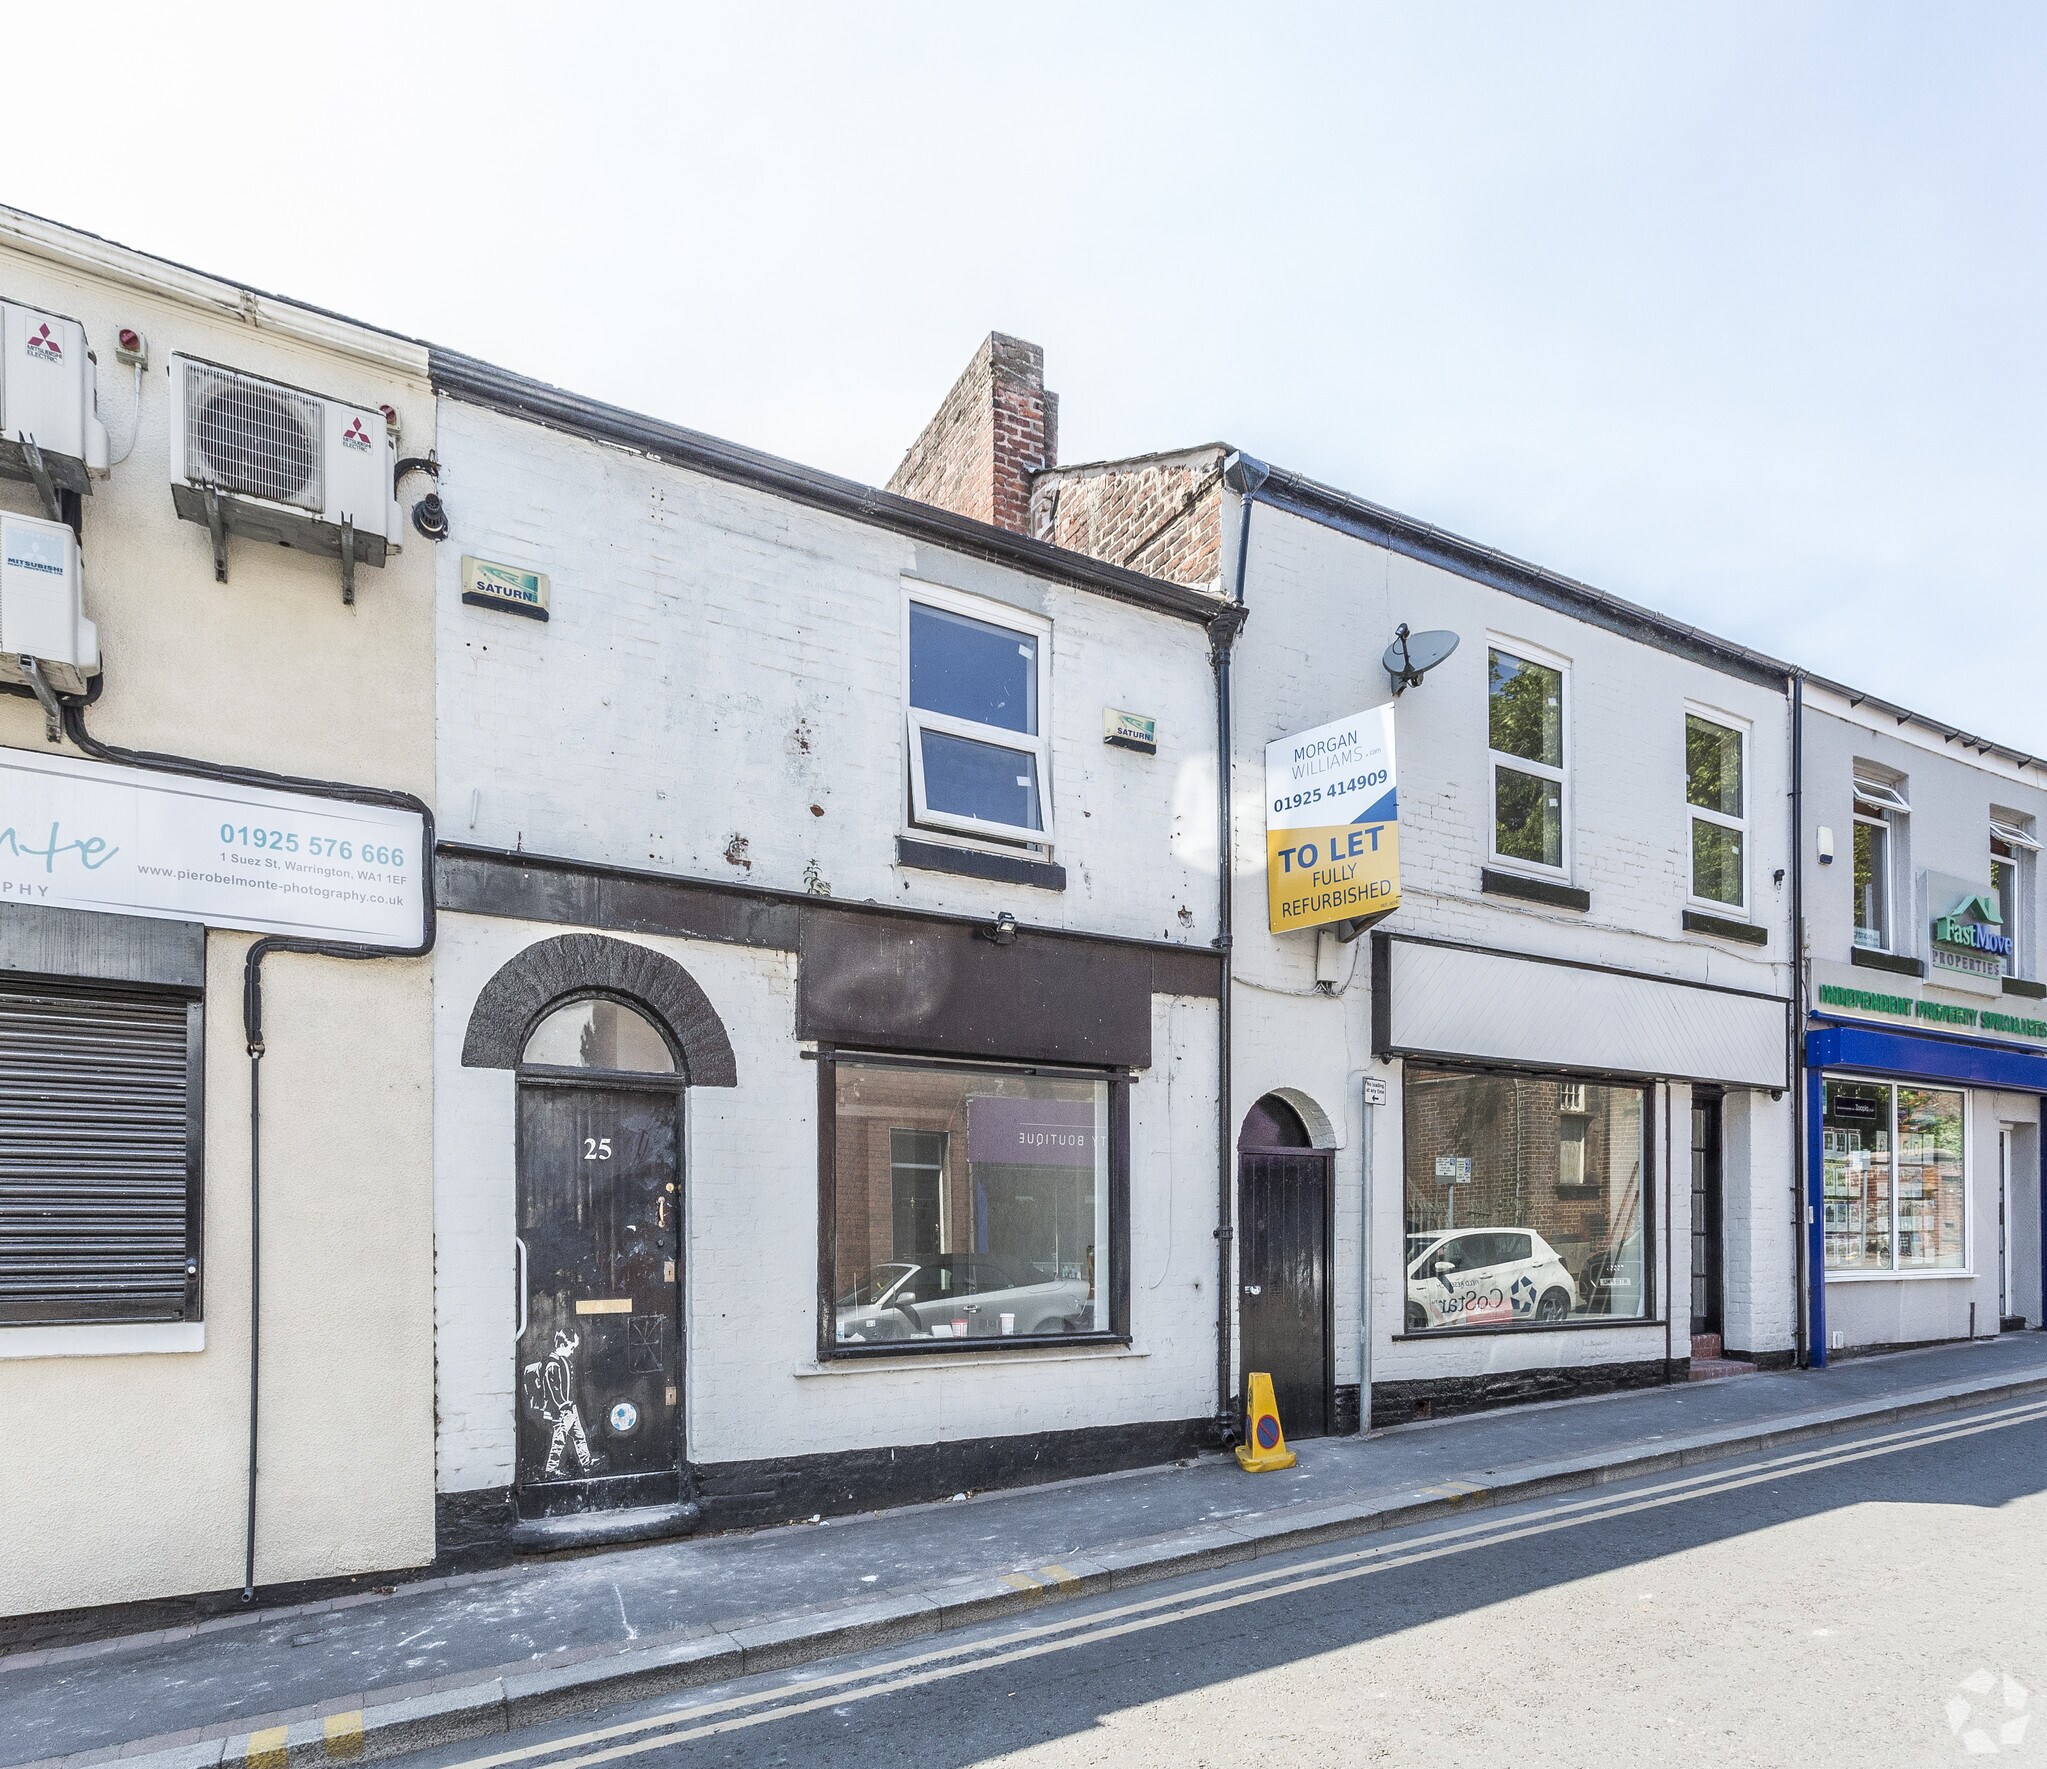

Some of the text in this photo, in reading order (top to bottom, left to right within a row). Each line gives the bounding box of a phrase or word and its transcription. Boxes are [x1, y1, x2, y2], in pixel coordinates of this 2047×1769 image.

[27, 350, 58, 363] ELECTRIC
[8, 558, 63, 573] MITSUBISHI
[477, 581, 532, 602] SATURN
[1117, 727, 1151, 741] SATURN
[1294, 730, 1358, 763] MORGAN
[1274, 768, 1388, 813] 01925 414909
[220, 823, 405, 867] 01925 576 666
[1278, 825, 1385, 874] TO LET
[138, 864, 404, 906] www.pierobelmonte-photography.co.uk
[220, 852, 408, 886] 1 Suez St, Warrington, WA1 1EF
[1313, 862, 1358, 888] FULLY
[1282, 879, 1391, 918] REFURBISHED
[1932, 950, 1999, 976] PROPERTIES
[1820, 985, 1913, 1016] INDEPENDENT
[1917, 1000, 1978, 1026] PROPERTY
[584, 1138, 612, 1160] 25
